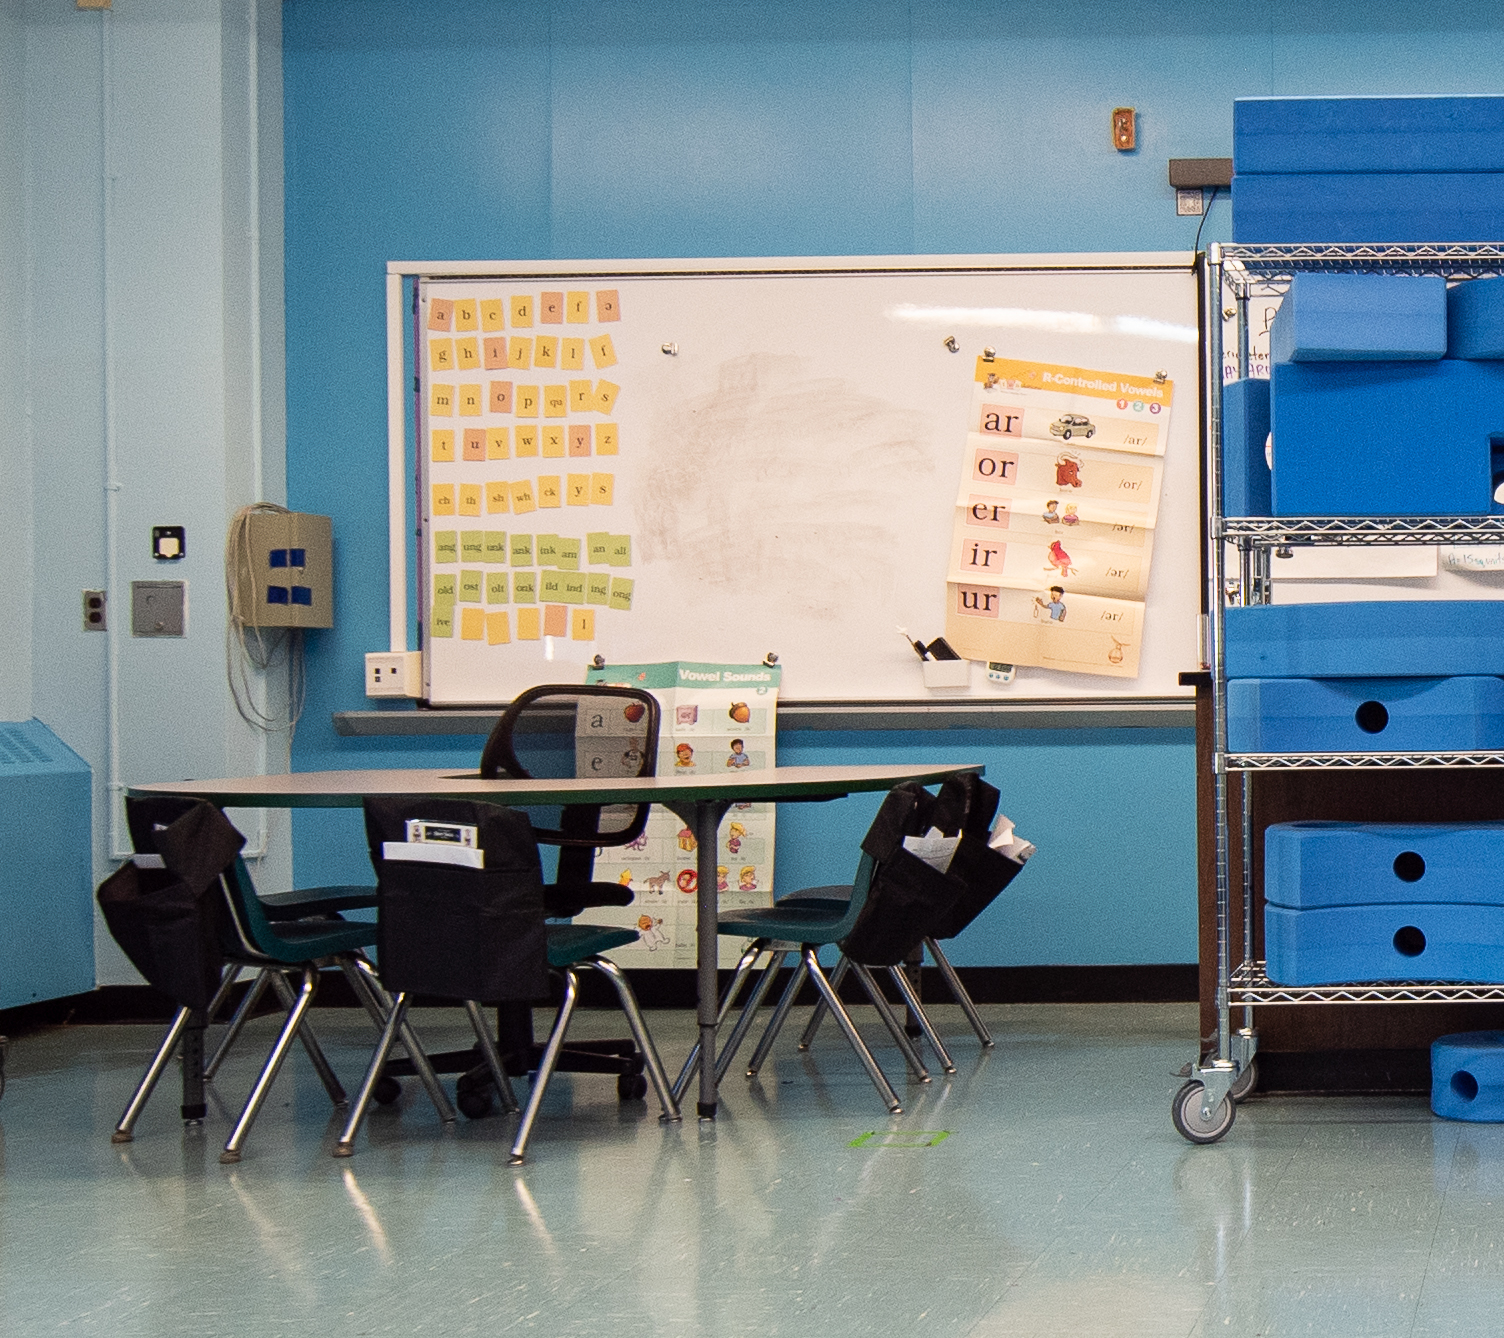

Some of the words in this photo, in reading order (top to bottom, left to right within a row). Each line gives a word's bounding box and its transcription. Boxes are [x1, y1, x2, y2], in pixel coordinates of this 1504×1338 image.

[436, 311, 445, 321] a
[461, 309, 472, 321] b
[488, 311, 496, 321] c
[517, 305, 527, 317] d
[547, 304, 556, 313] e
[438, 350, 448, 363] g
[463, 347, 473, 359] h
[516, 347, 523, 361] j
[541, 345, 551, 358] k
[1042, 371, 1117, 392] R-Controlled
[1120, 382, 1164, 398] Vowels
[436, 396, 450, 406] m
[466, 396, 476, 406] n
[496, 393, 506, 402] o
[524, 397, 533, 410] p
[578, 392, 585, 401] r
[602, 393, 609, 402] s
[984, 412, 1019, 433] ar
[1123, 434, 1148, 446] /ar/
[441, 440, 447, 451] t
[470, 441, 480, 450] u
[494, 439, 503, 448] v
[521, 437, 533, 446] w
[550, 436, 558, 445] x
[576, 437, 584, 449] y
[604, 435, 612, 445] z
[978, 457, 1015, 478] or
[1118, 478, 1143, 491] /or/
[437, 496, 451, 505] ch
[492, 493, 505, 503] sh
[543, 488, 556, 497] ck
[574, 486, 583, 498] y
[599, 486, 607, 494] s
[972, 502, 1006, 522] er
[437, 543, 457, 553] ang
[462, 543, 483, 553] ung
[561, 551, 578, 559] am
[592, 545, 606, 554] an
[969, 543, 998, 567] ir
[515, 583, 534, 593] onk
[590, 585, 607, 596] ing
[612, 590, 632, 602] ong
[961, 589, 998, 611] ur
[679, 669, 720, 681] Vowel
[723, 671, 771, 682] Sounds
[591, 714, 603, 729] a
[591, 756, 603, 771] e
